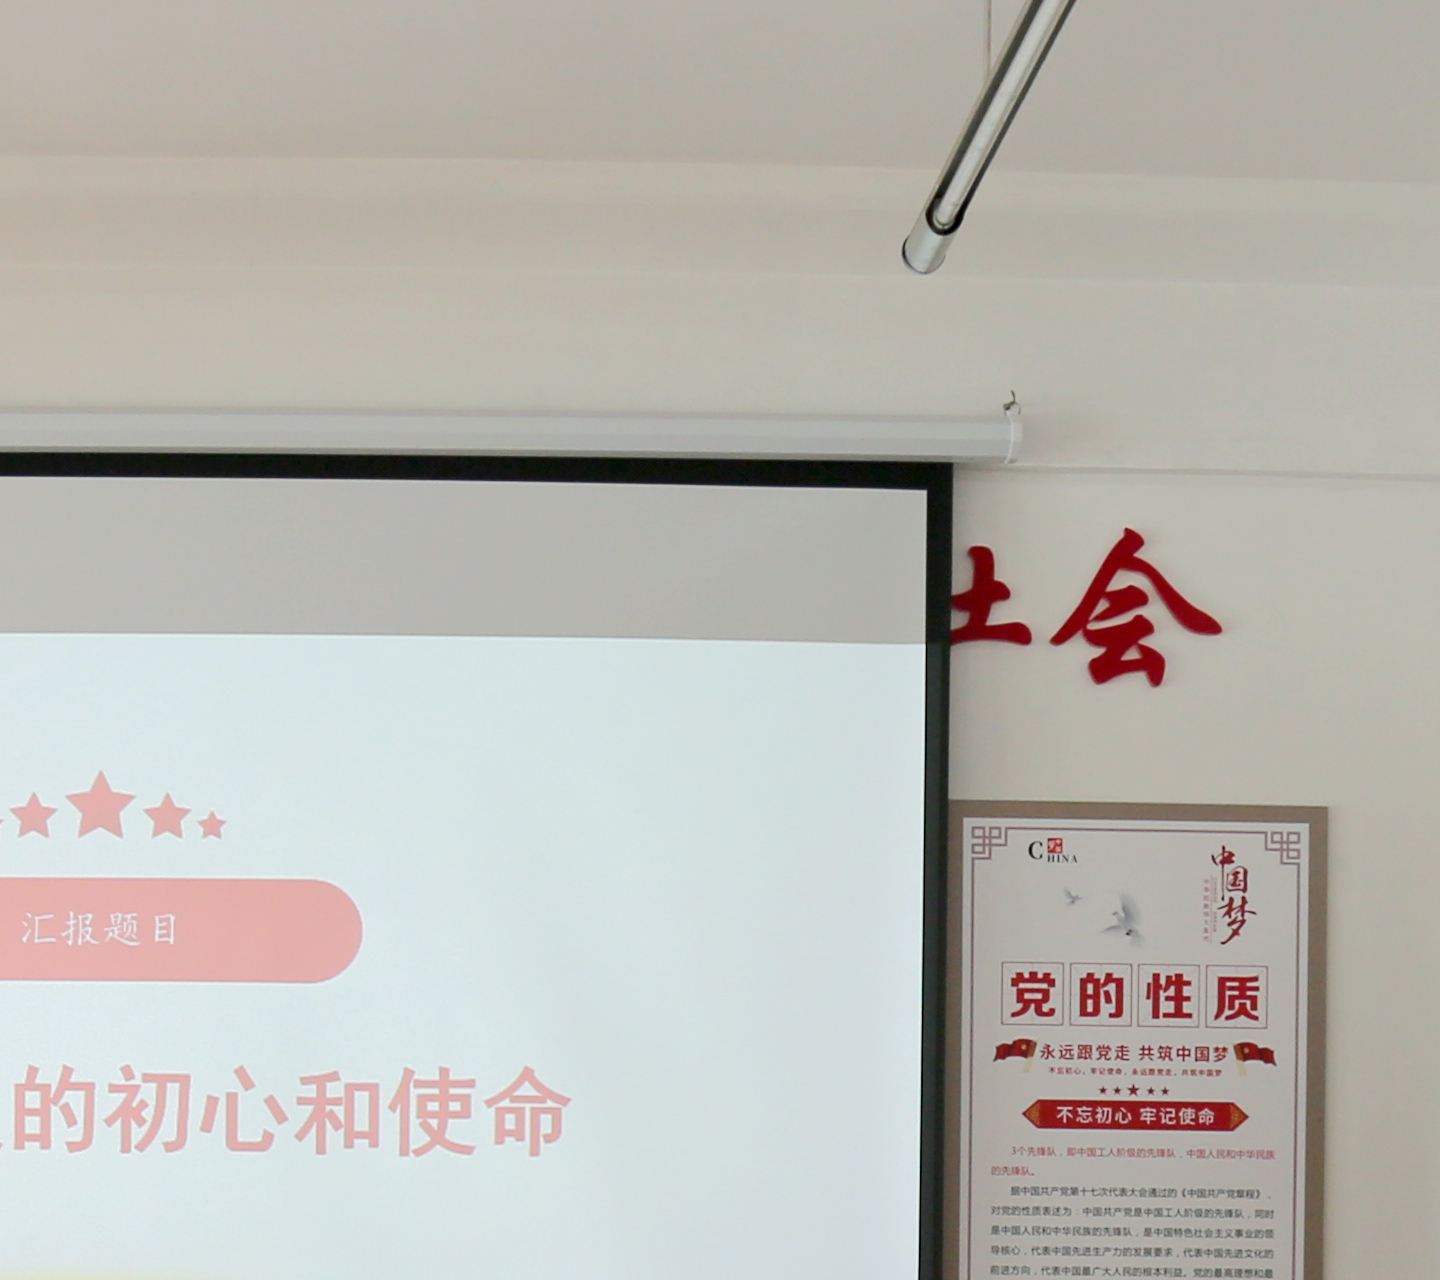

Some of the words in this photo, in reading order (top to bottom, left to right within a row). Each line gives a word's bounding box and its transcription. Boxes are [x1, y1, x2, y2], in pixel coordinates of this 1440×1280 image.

[1211, 845, 1257, 945] 中国梦
[21, 911, 177, 947] 汇报题目
[1010, 970, 1260, 1022] 党的性质
[1040, 1043, 1130, 1061] 永远跟党走
[1138, 1045, 1230, 1062] 共筑中国梦
[1056, 1105, 1132, 1124] 不忘初心
[1139, 1107, 1216, 1126] 牢记使命
